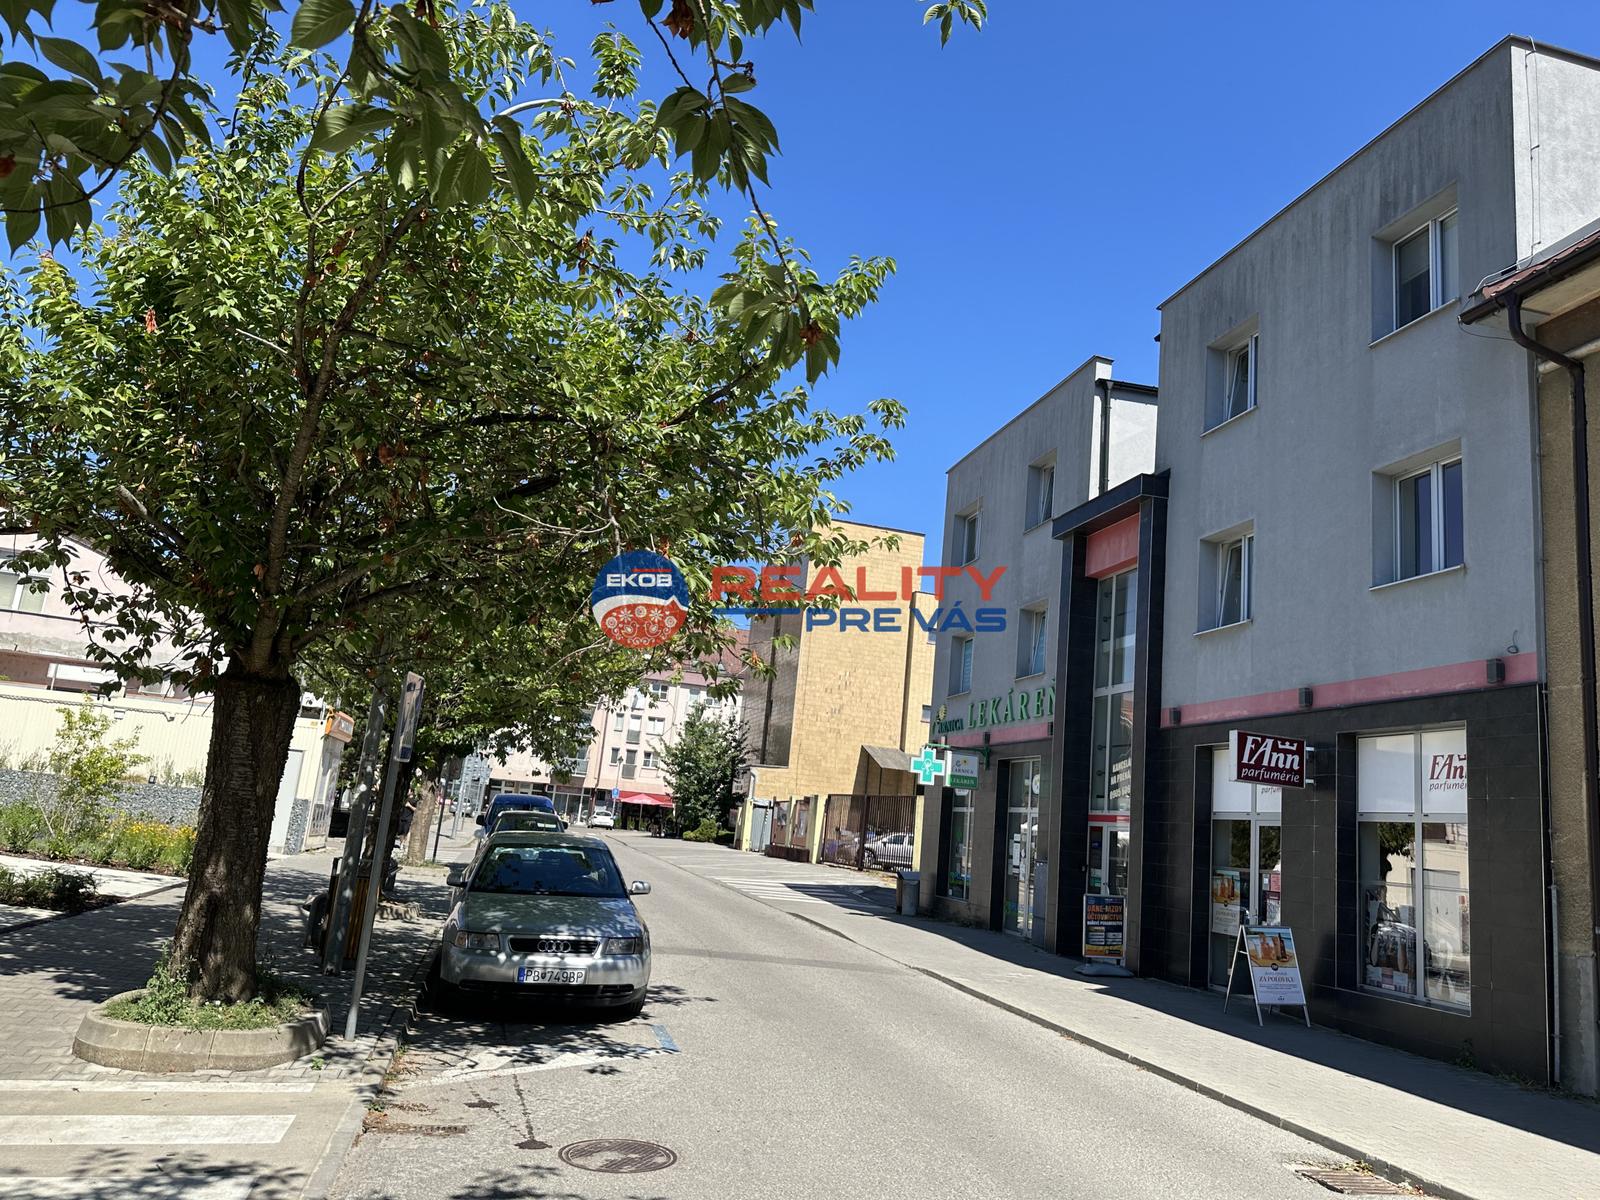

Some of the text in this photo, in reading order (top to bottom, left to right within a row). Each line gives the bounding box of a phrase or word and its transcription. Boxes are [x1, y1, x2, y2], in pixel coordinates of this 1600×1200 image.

[1241, 735, 1300, 770] FAnn
[1241, 767, 1300, 783] parfumérie
[1429, 754, 1467, 780] FAn
